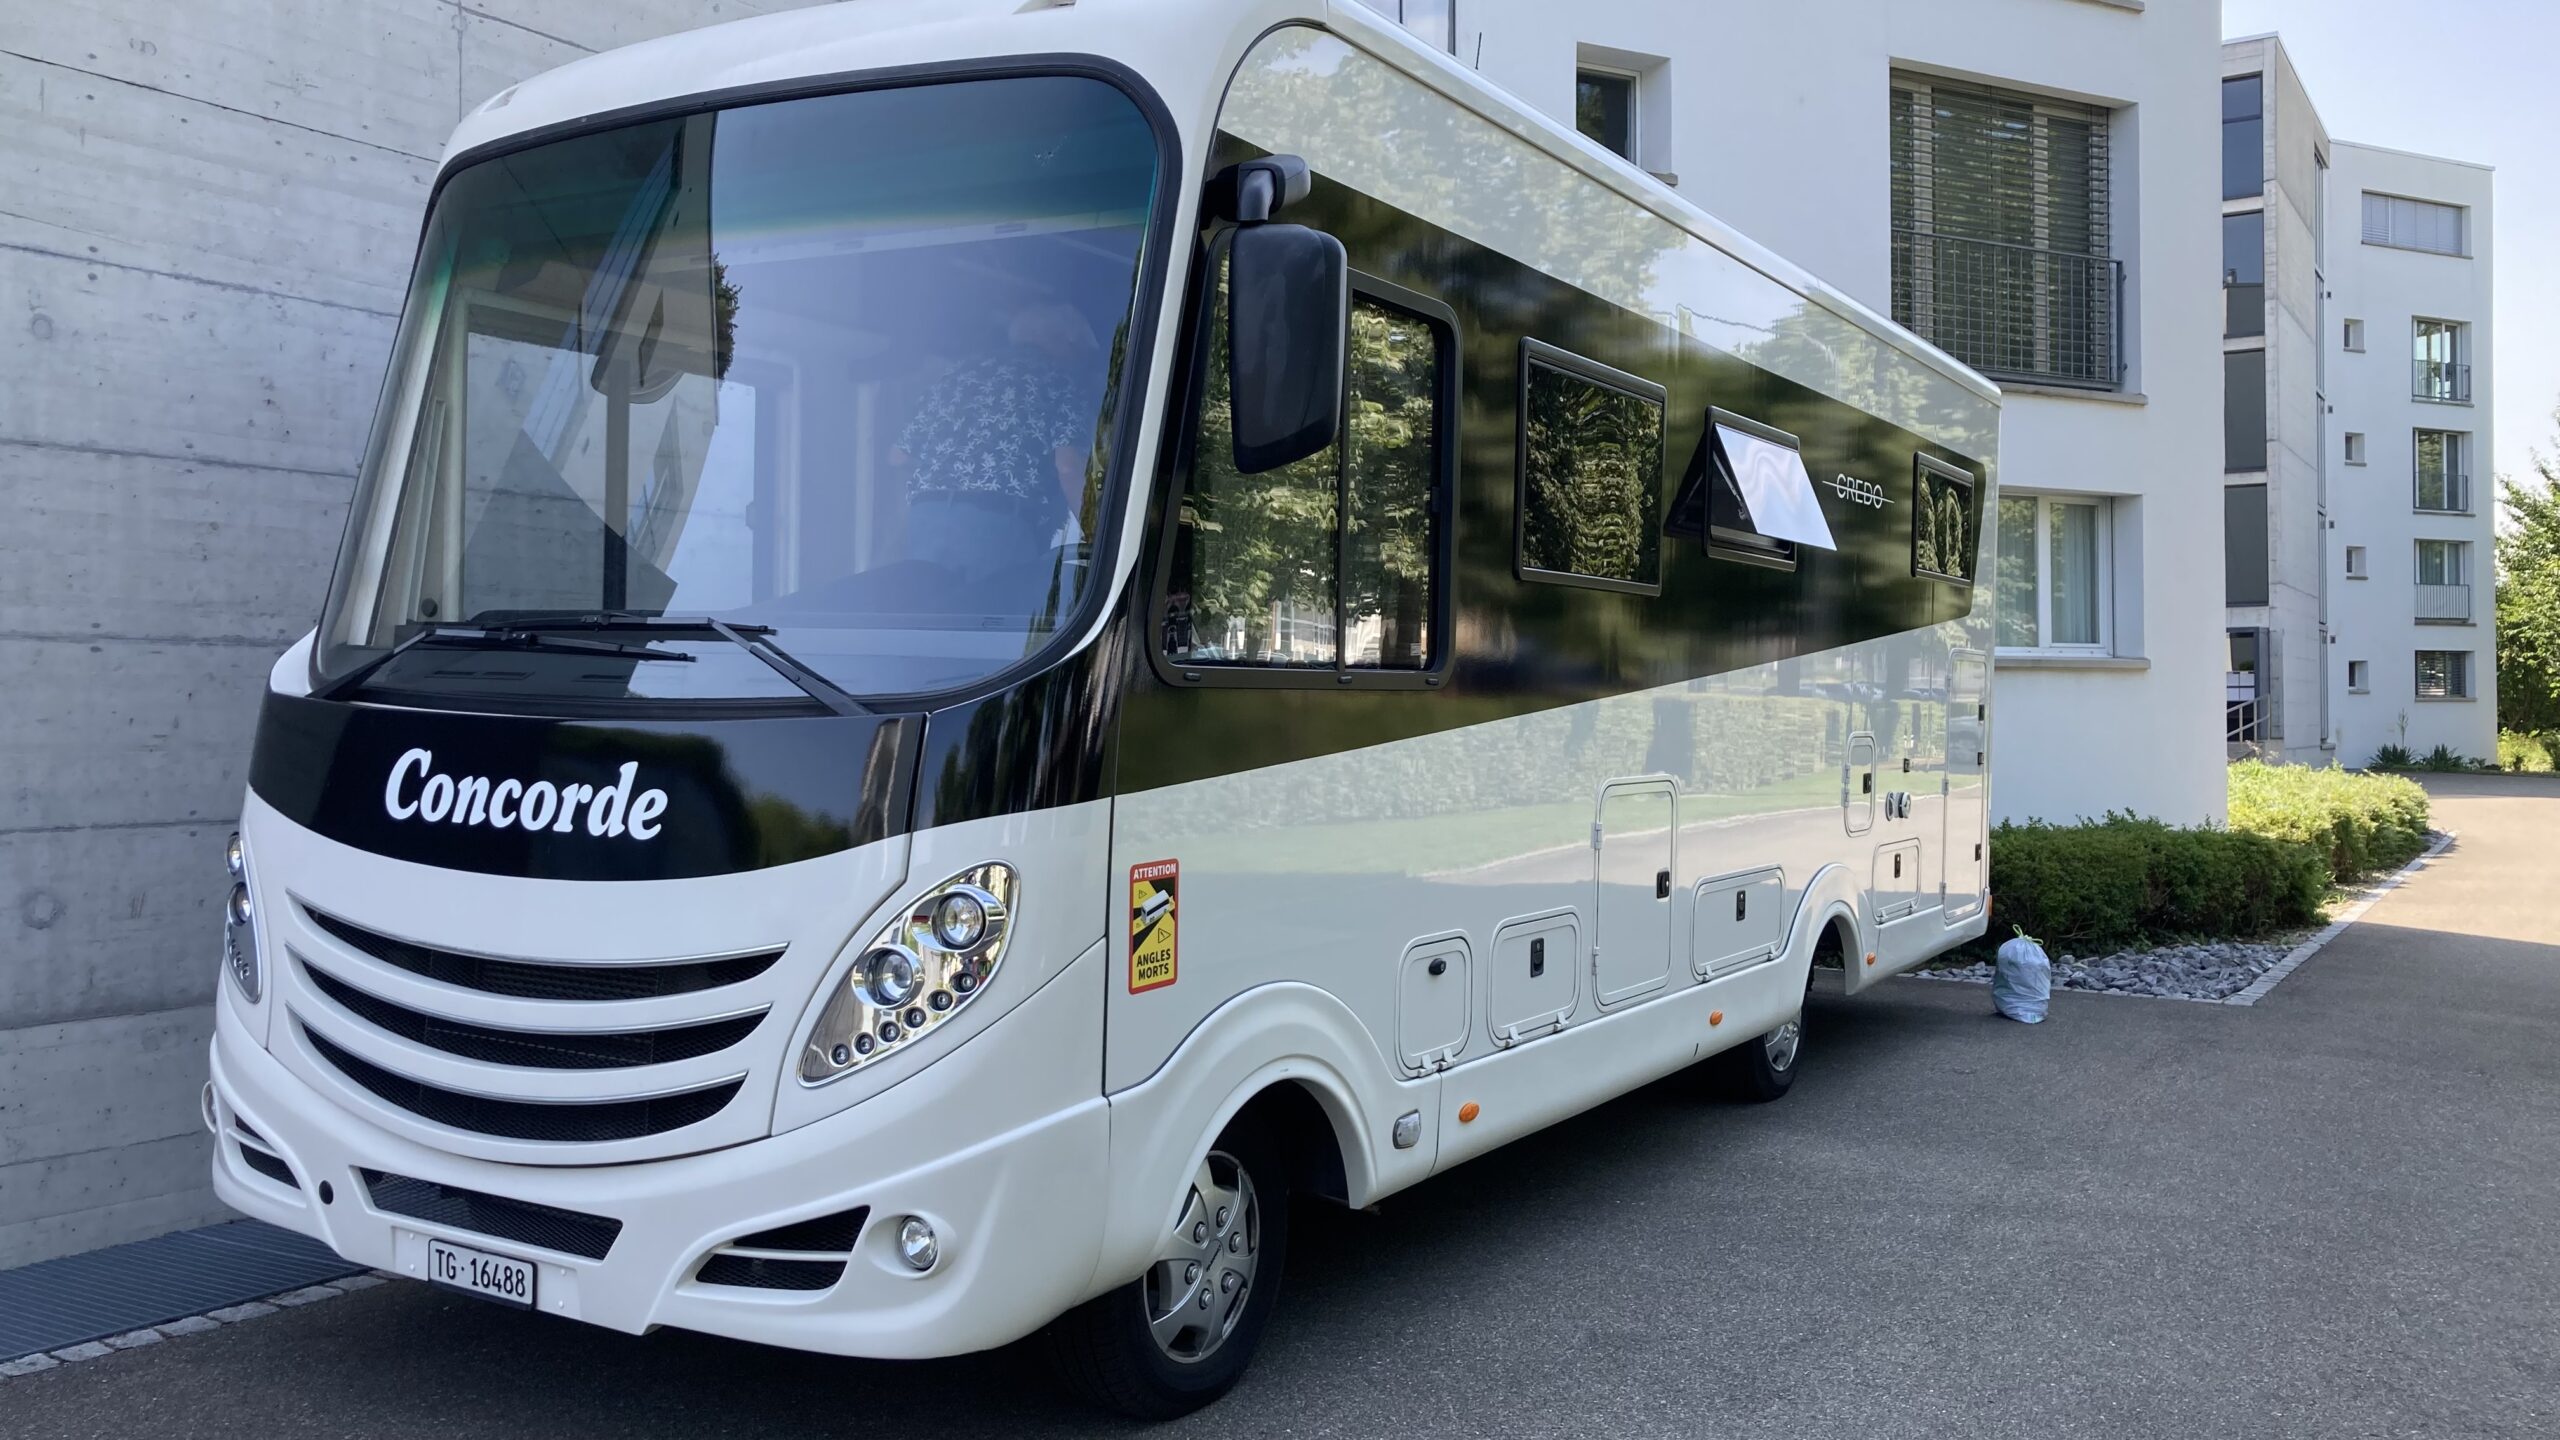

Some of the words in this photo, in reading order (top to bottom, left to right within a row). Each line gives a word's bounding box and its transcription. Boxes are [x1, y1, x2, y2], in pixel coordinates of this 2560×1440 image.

[1836, 473, 1884, 510] CREDO
[385, 747, 669, 841] Concorde
[1133, 862, 1177, 880] ATTENTION
[1136, 948, 1171, 968] ANGLES
[1138, 962, 1169, 982] MORTS
